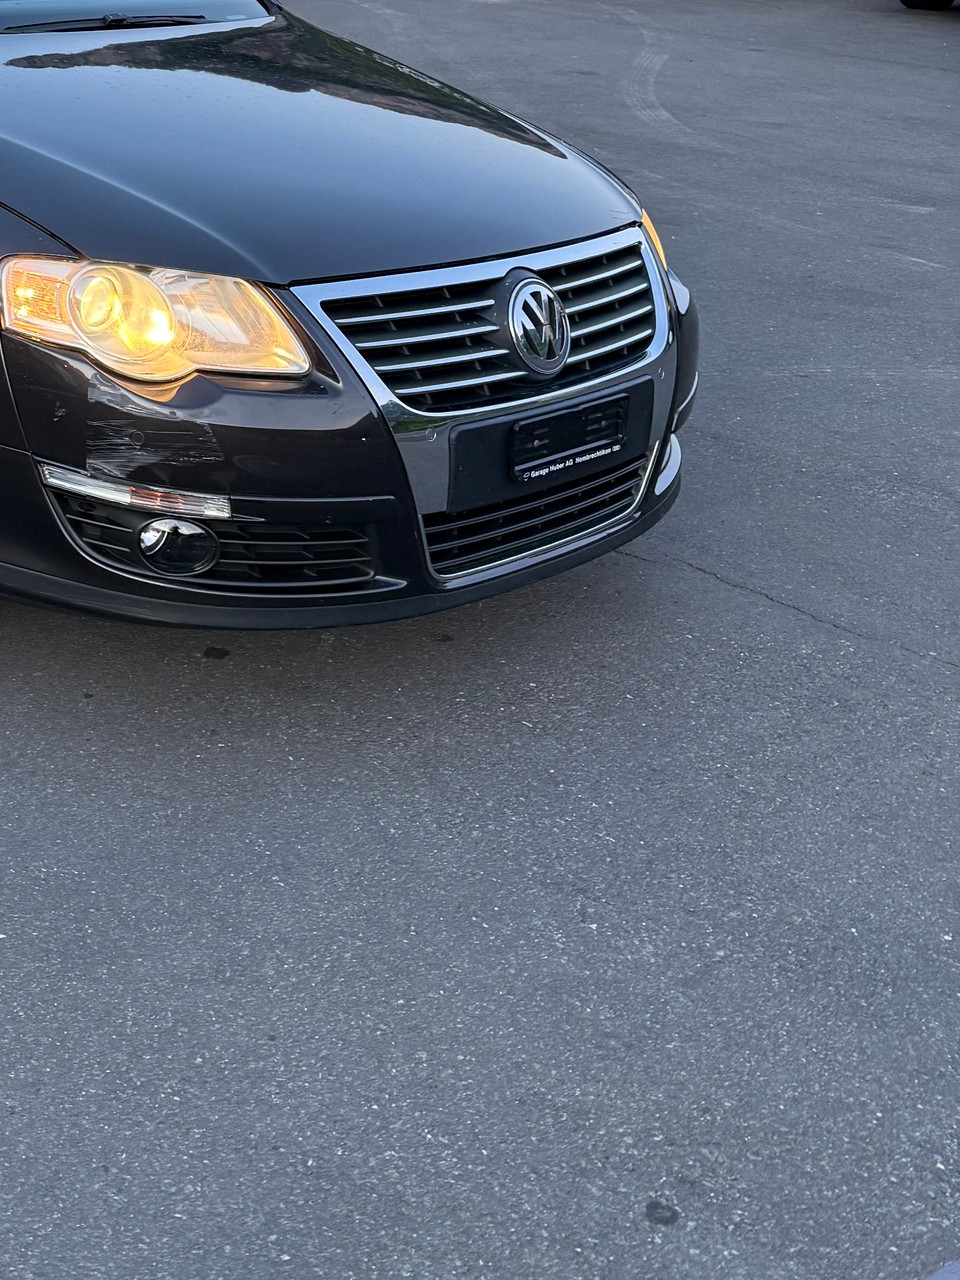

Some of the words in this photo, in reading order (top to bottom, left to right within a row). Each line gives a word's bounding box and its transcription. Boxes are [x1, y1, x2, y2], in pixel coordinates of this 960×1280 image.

[530, 467, 549, 478] Garage
[549, 462, 565, 472] Huber
[565, 458, 574, 467] AG
